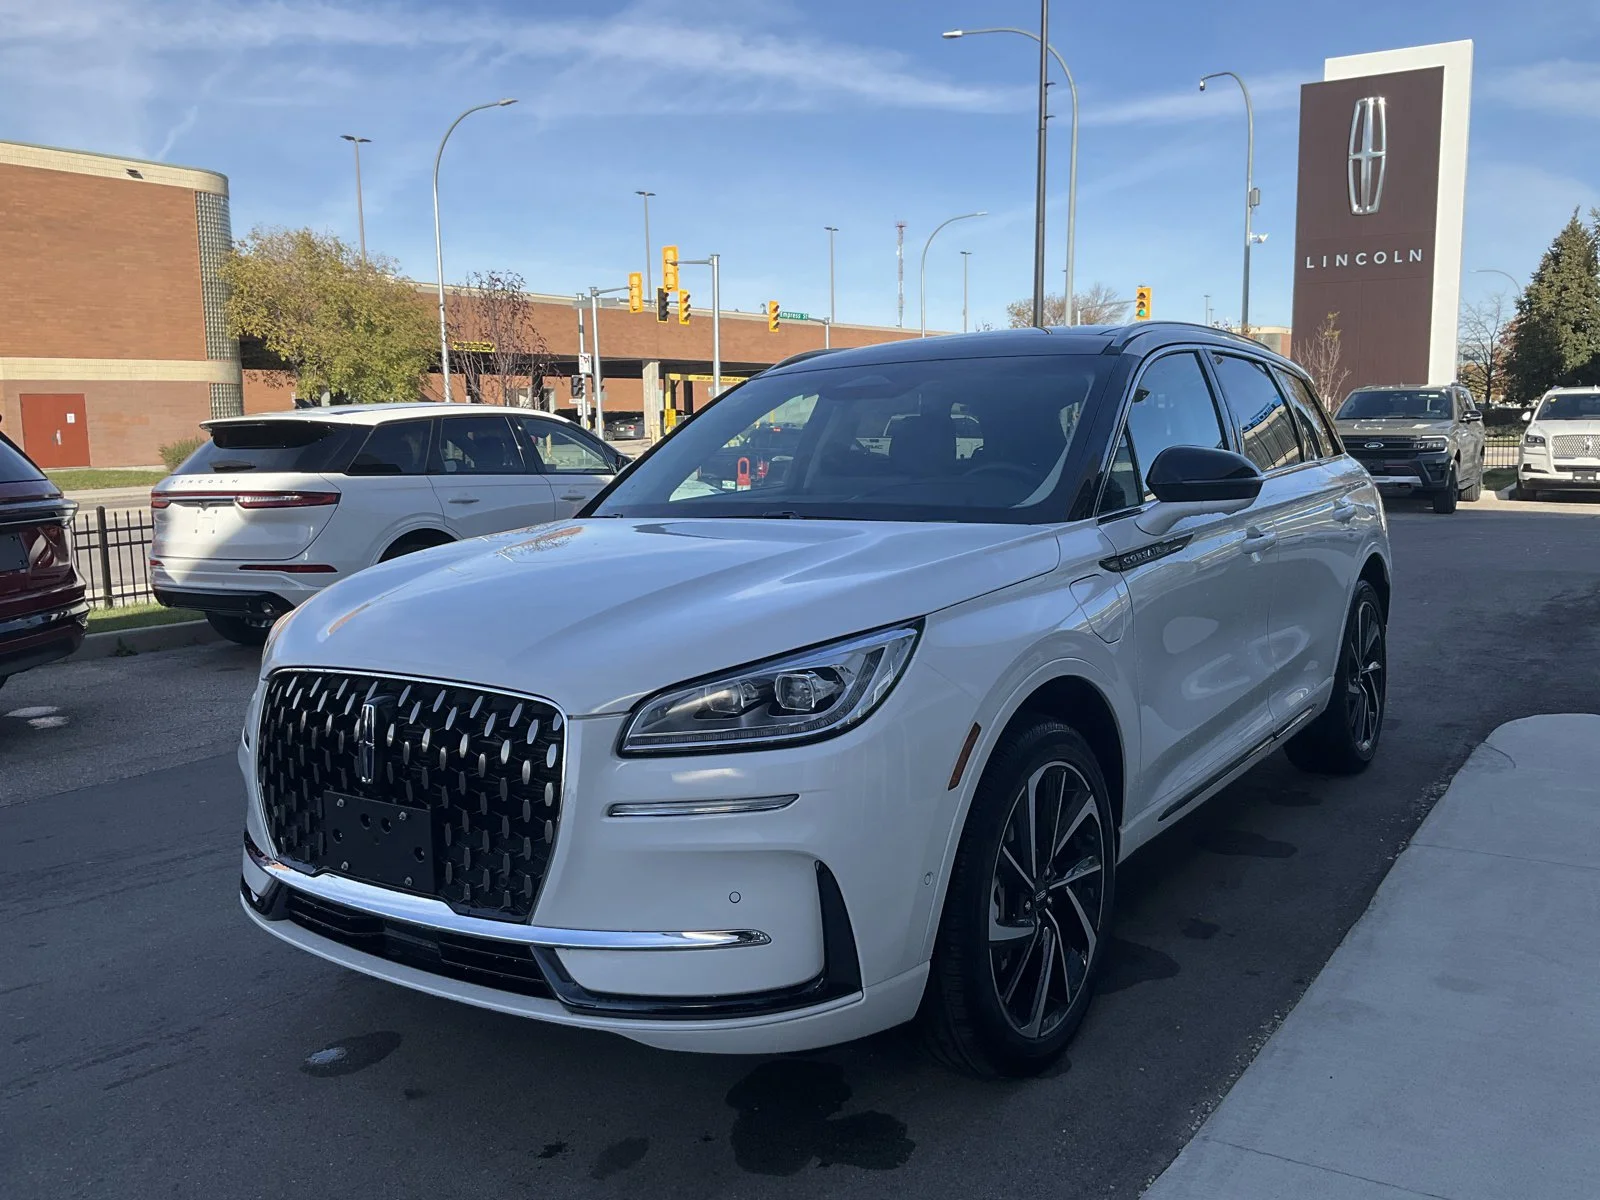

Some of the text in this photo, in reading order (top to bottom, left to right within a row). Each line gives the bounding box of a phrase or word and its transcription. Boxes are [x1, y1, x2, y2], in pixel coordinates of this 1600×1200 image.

[1306, 249, 1422, 269] LINCOLN
[780, 311, 801, 319] Empress
[1123, 546, 1161, 564] CORSAIR
